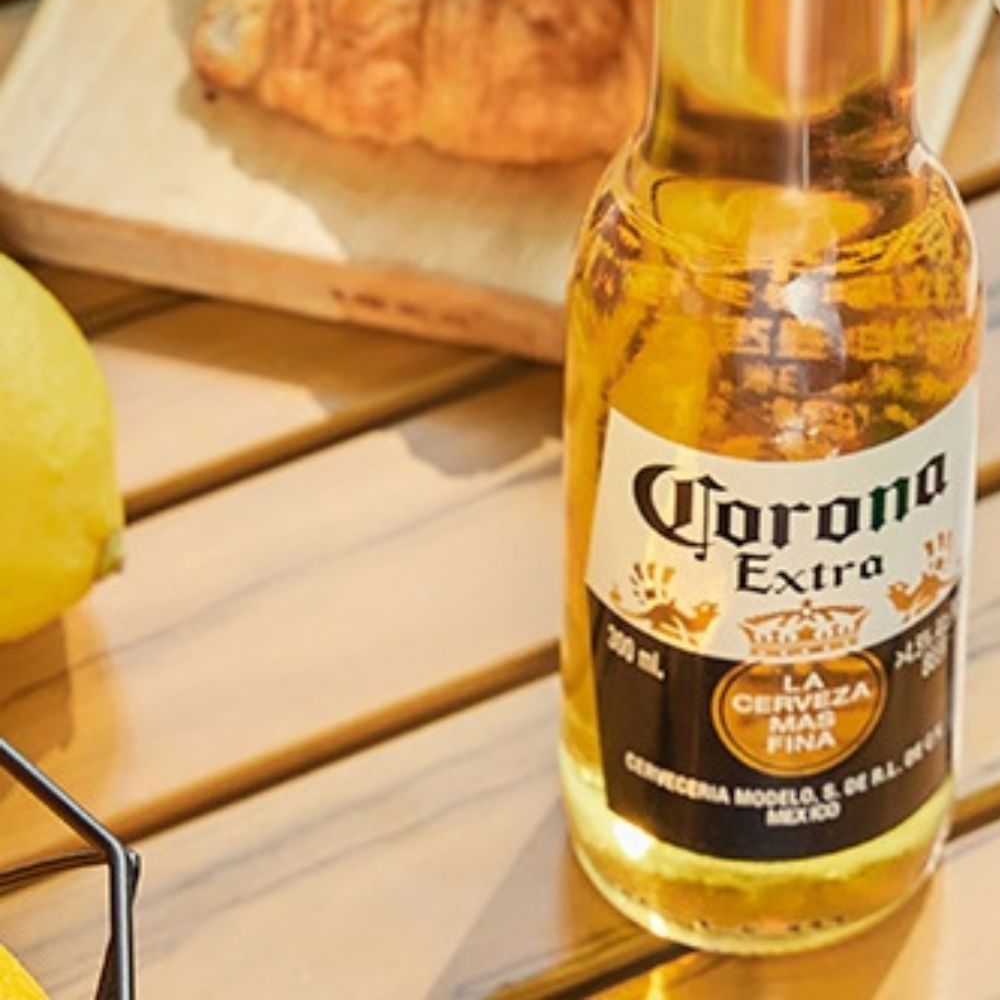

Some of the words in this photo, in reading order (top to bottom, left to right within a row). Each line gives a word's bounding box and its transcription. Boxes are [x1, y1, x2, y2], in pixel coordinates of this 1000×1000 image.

[632, 452, 949, 561] Corona
[736, 552, 884, 594] Extra
[783, 671, 825, 693] LA
[731, 680, 872, 716] CERVEZA
[768, 709, 837, 734] MAS
[766, 730, 837, 755] FINA
[624, 751, 730, 805] CERVECERIA
[843, 771, 868, 797] DE
[765, 800, 842, 827] MEXICO
